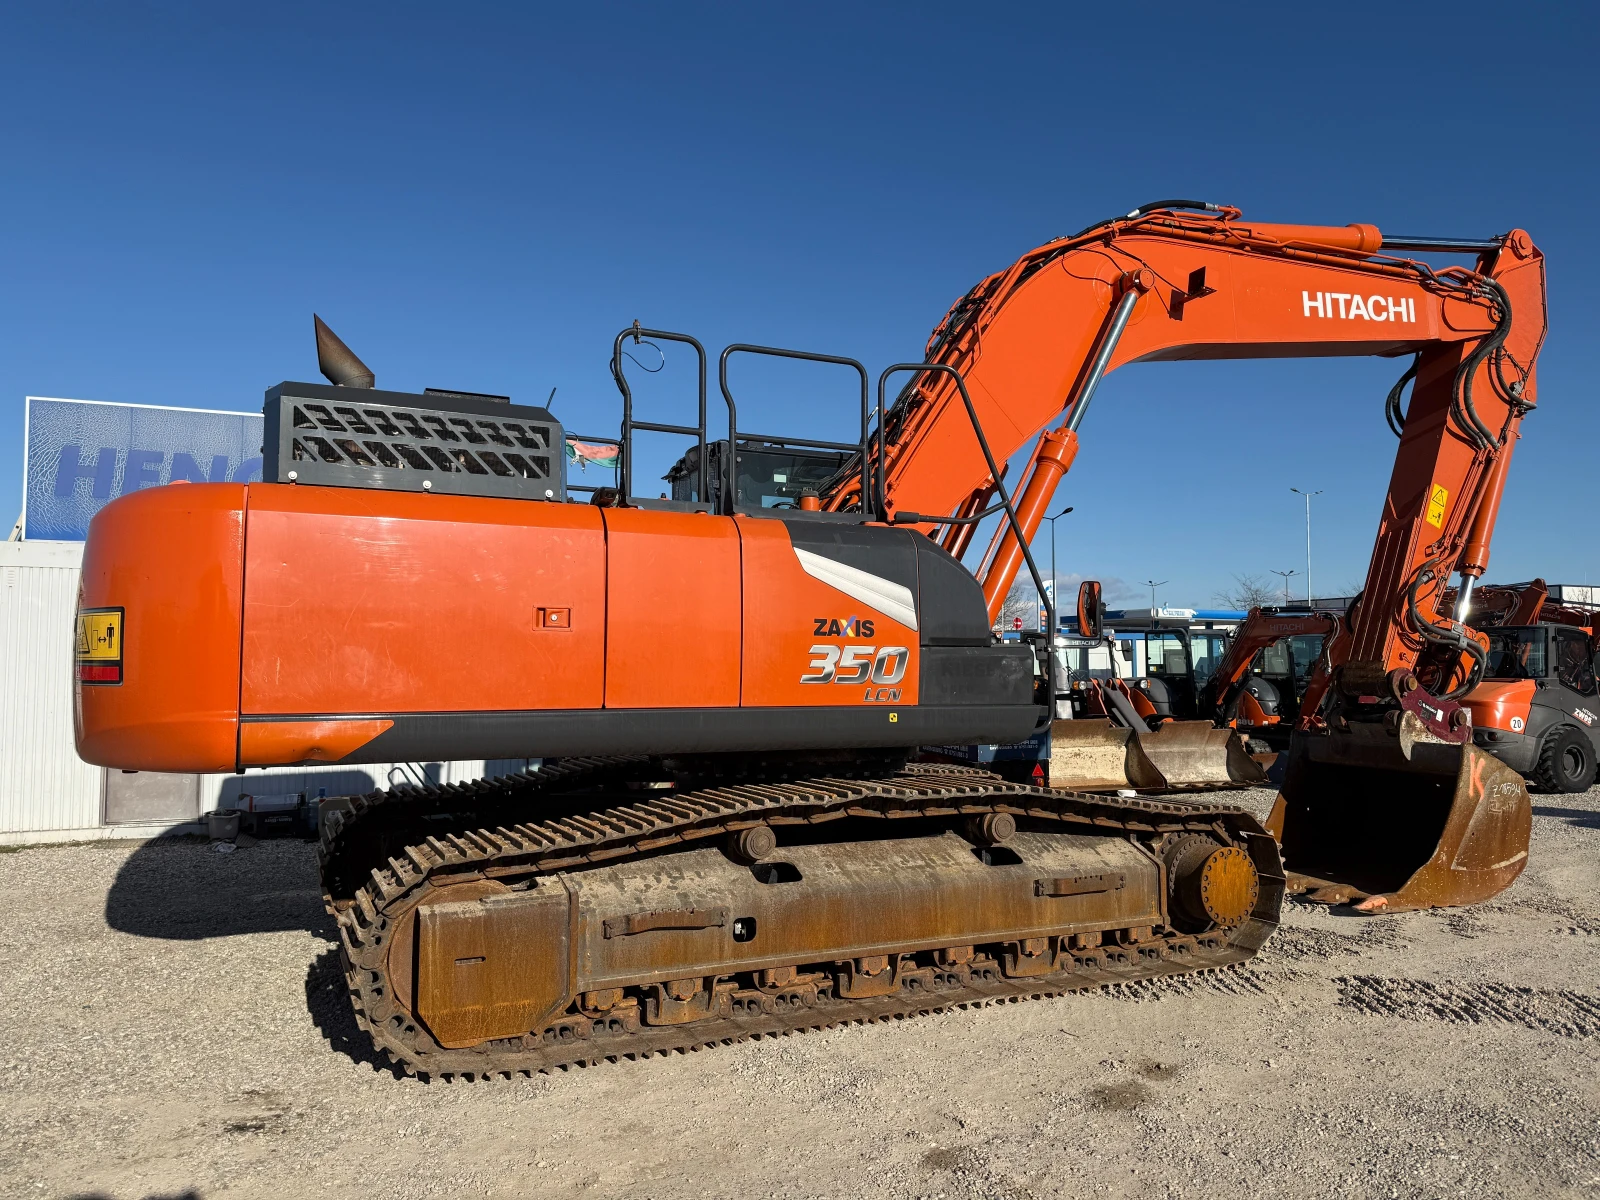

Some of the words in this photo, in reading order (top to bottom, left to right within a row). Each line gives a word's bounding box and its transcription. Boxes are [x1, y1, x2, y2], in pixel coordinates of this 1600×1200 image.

[1302, 290, 1416, 323] HITACHI
[813, 615, 875, 638] ZAXIS
[1269, 622, 1305, 632] HITACHI
[799, 644, 910, 685] 350
[863, 687, 903, 703] LCN
[1512, 719, 1523, 730] 20
